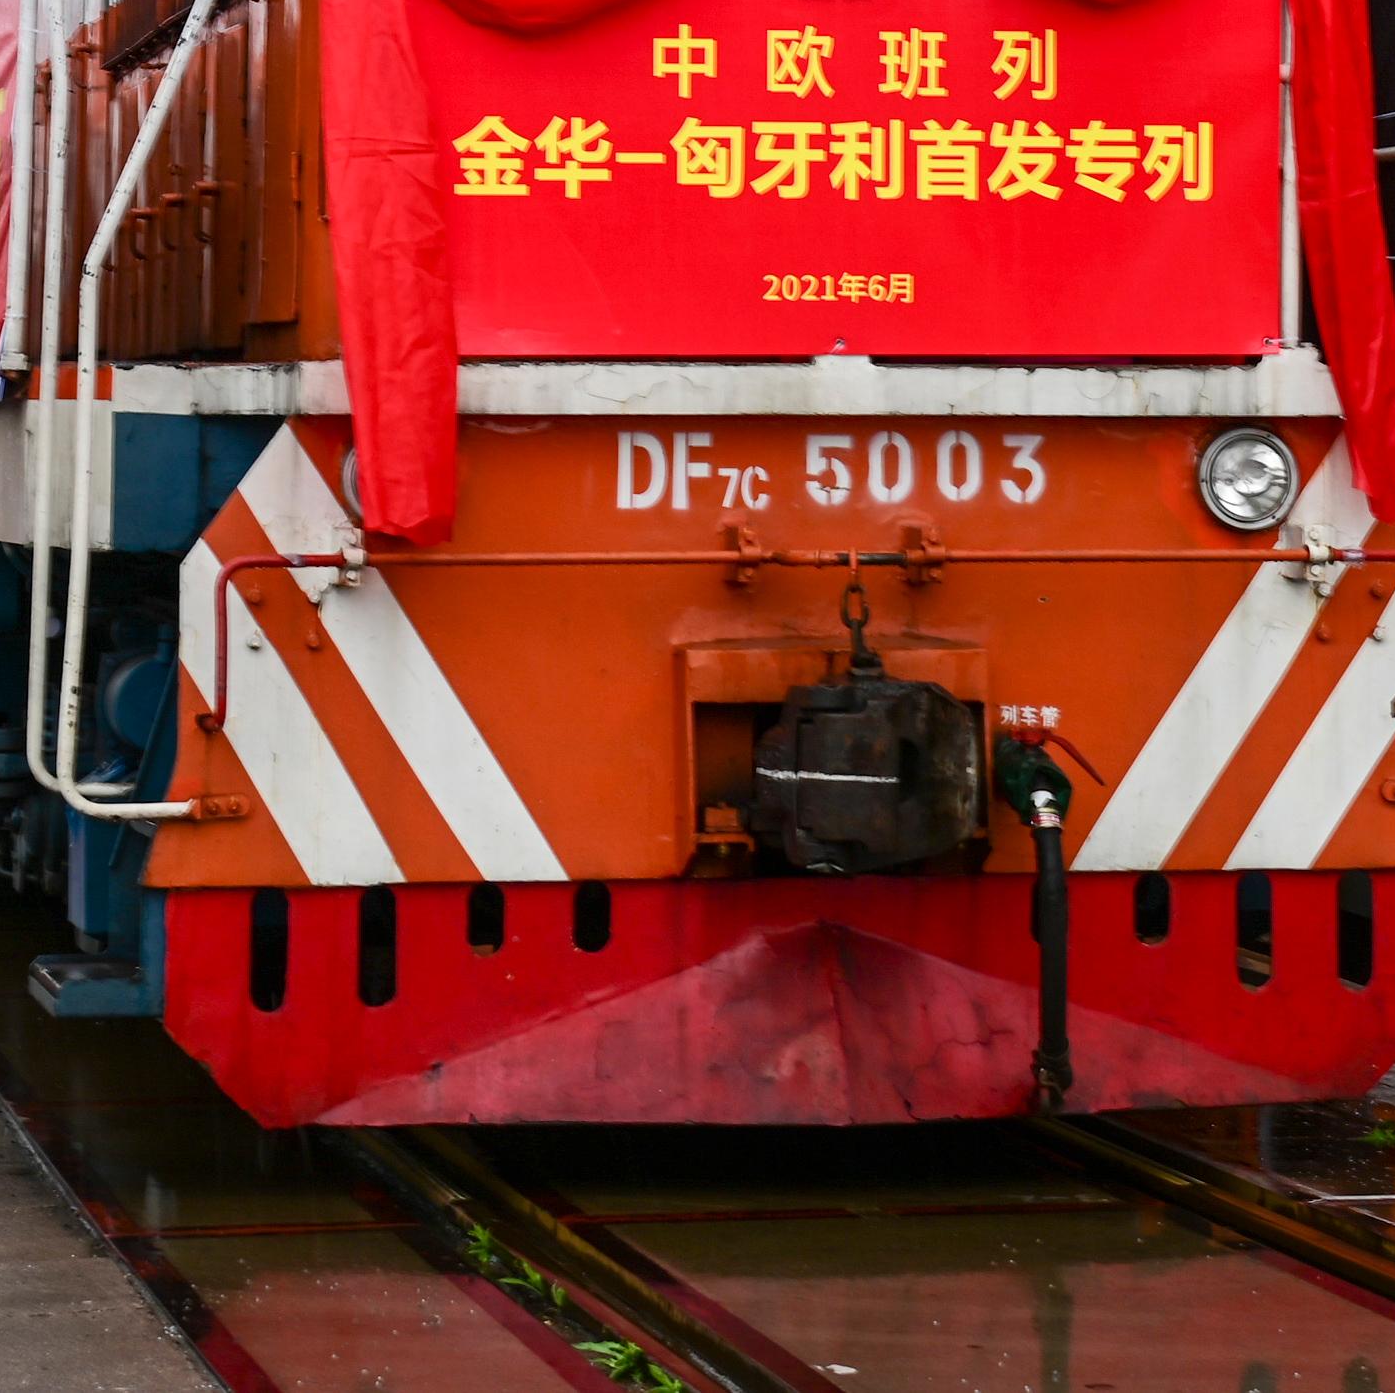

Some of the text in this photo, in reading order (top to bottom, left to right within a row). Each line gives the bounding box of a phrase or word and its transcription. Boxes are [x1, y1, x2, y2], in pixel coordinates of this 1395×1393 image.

[652, 23, 1058, 101] 中欧班列
[762, 271, 914, 303] 2021年6月
[806, 430, 1047, 506] 5003
[1000, 704, 1062, 727] 列车管
